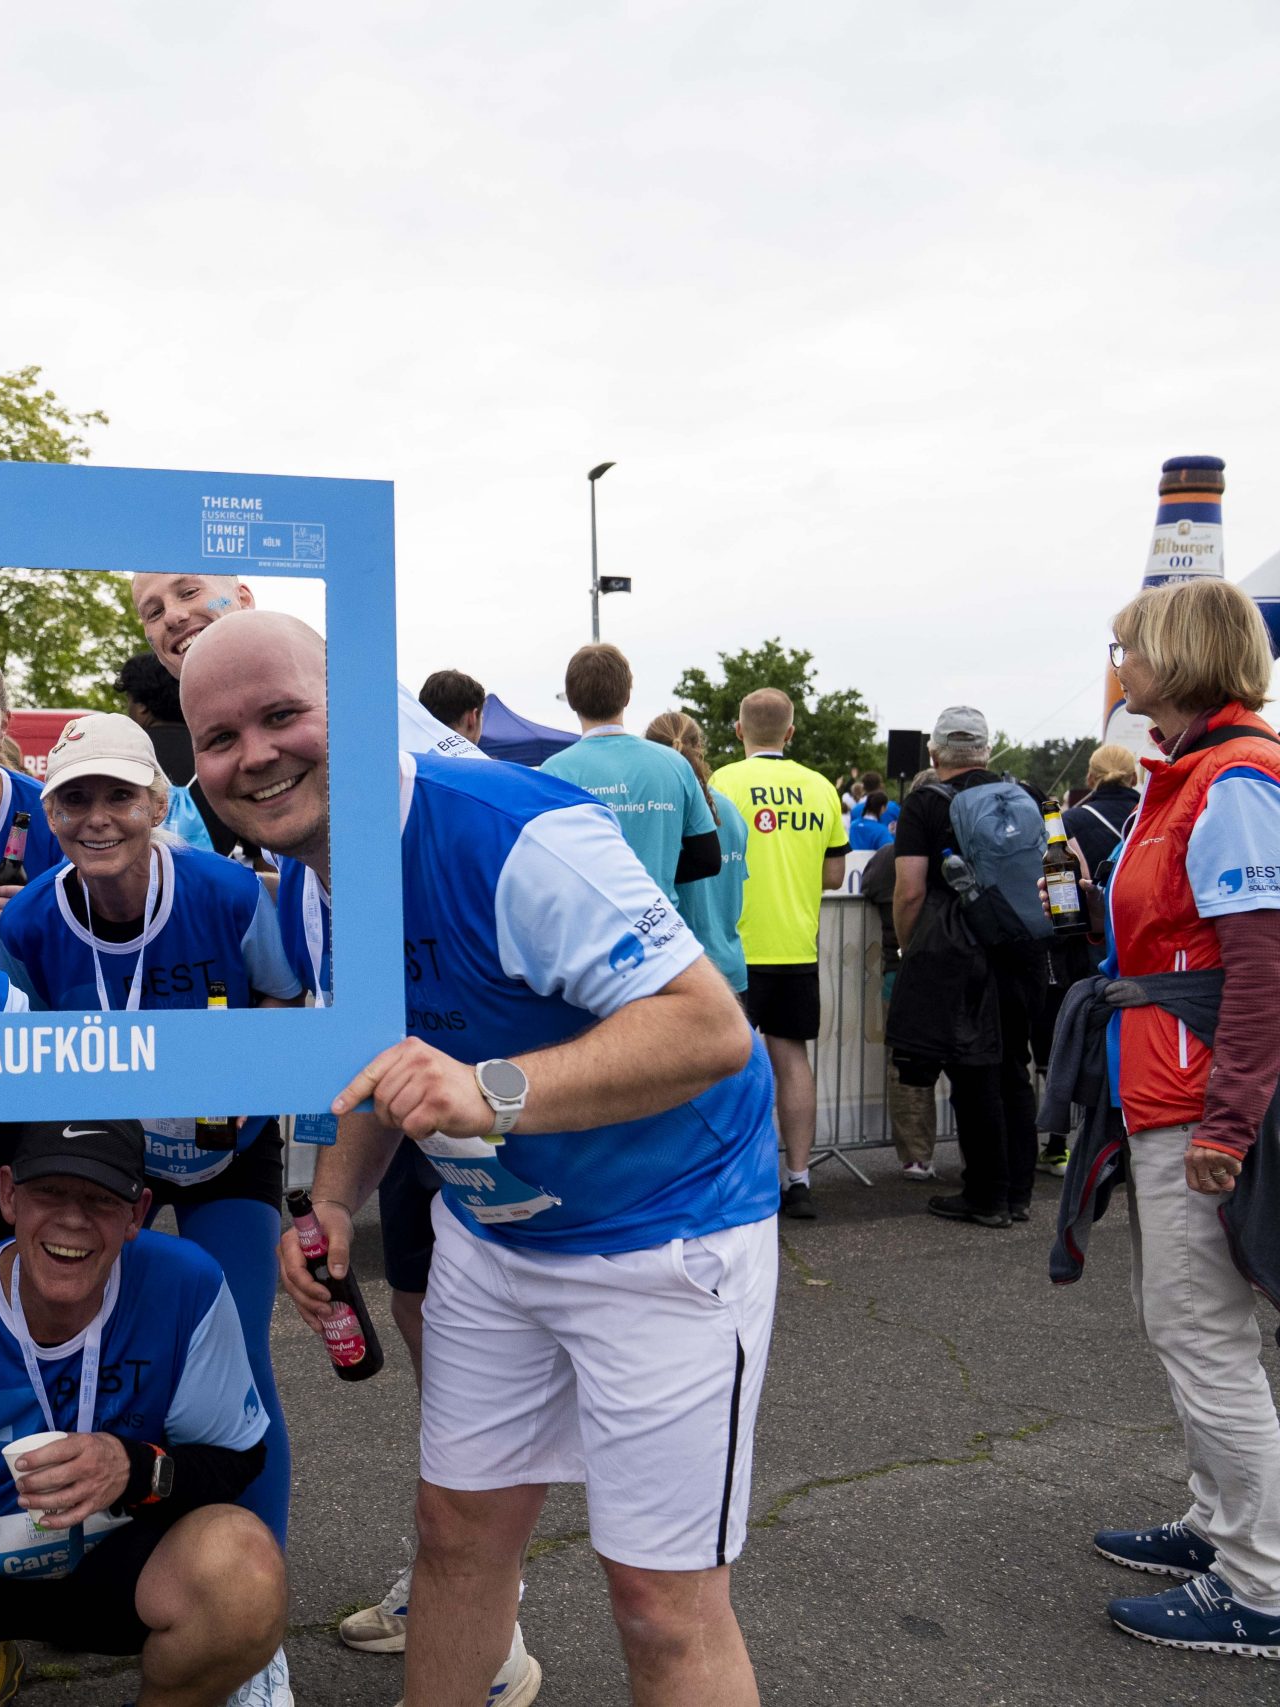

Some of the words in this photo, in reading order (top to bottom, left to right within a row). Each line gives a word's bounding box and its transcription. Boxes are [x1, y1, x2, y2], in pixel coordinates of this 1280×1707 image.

[202, 496, 263, 510] THERME
[202, 511, 263, 521] EUSKIRCHEN
[207, 524, 245, 536] FIRMEN
[207, 538, 245, 553] LAUF
[751, 787, 803, 805] RUN
